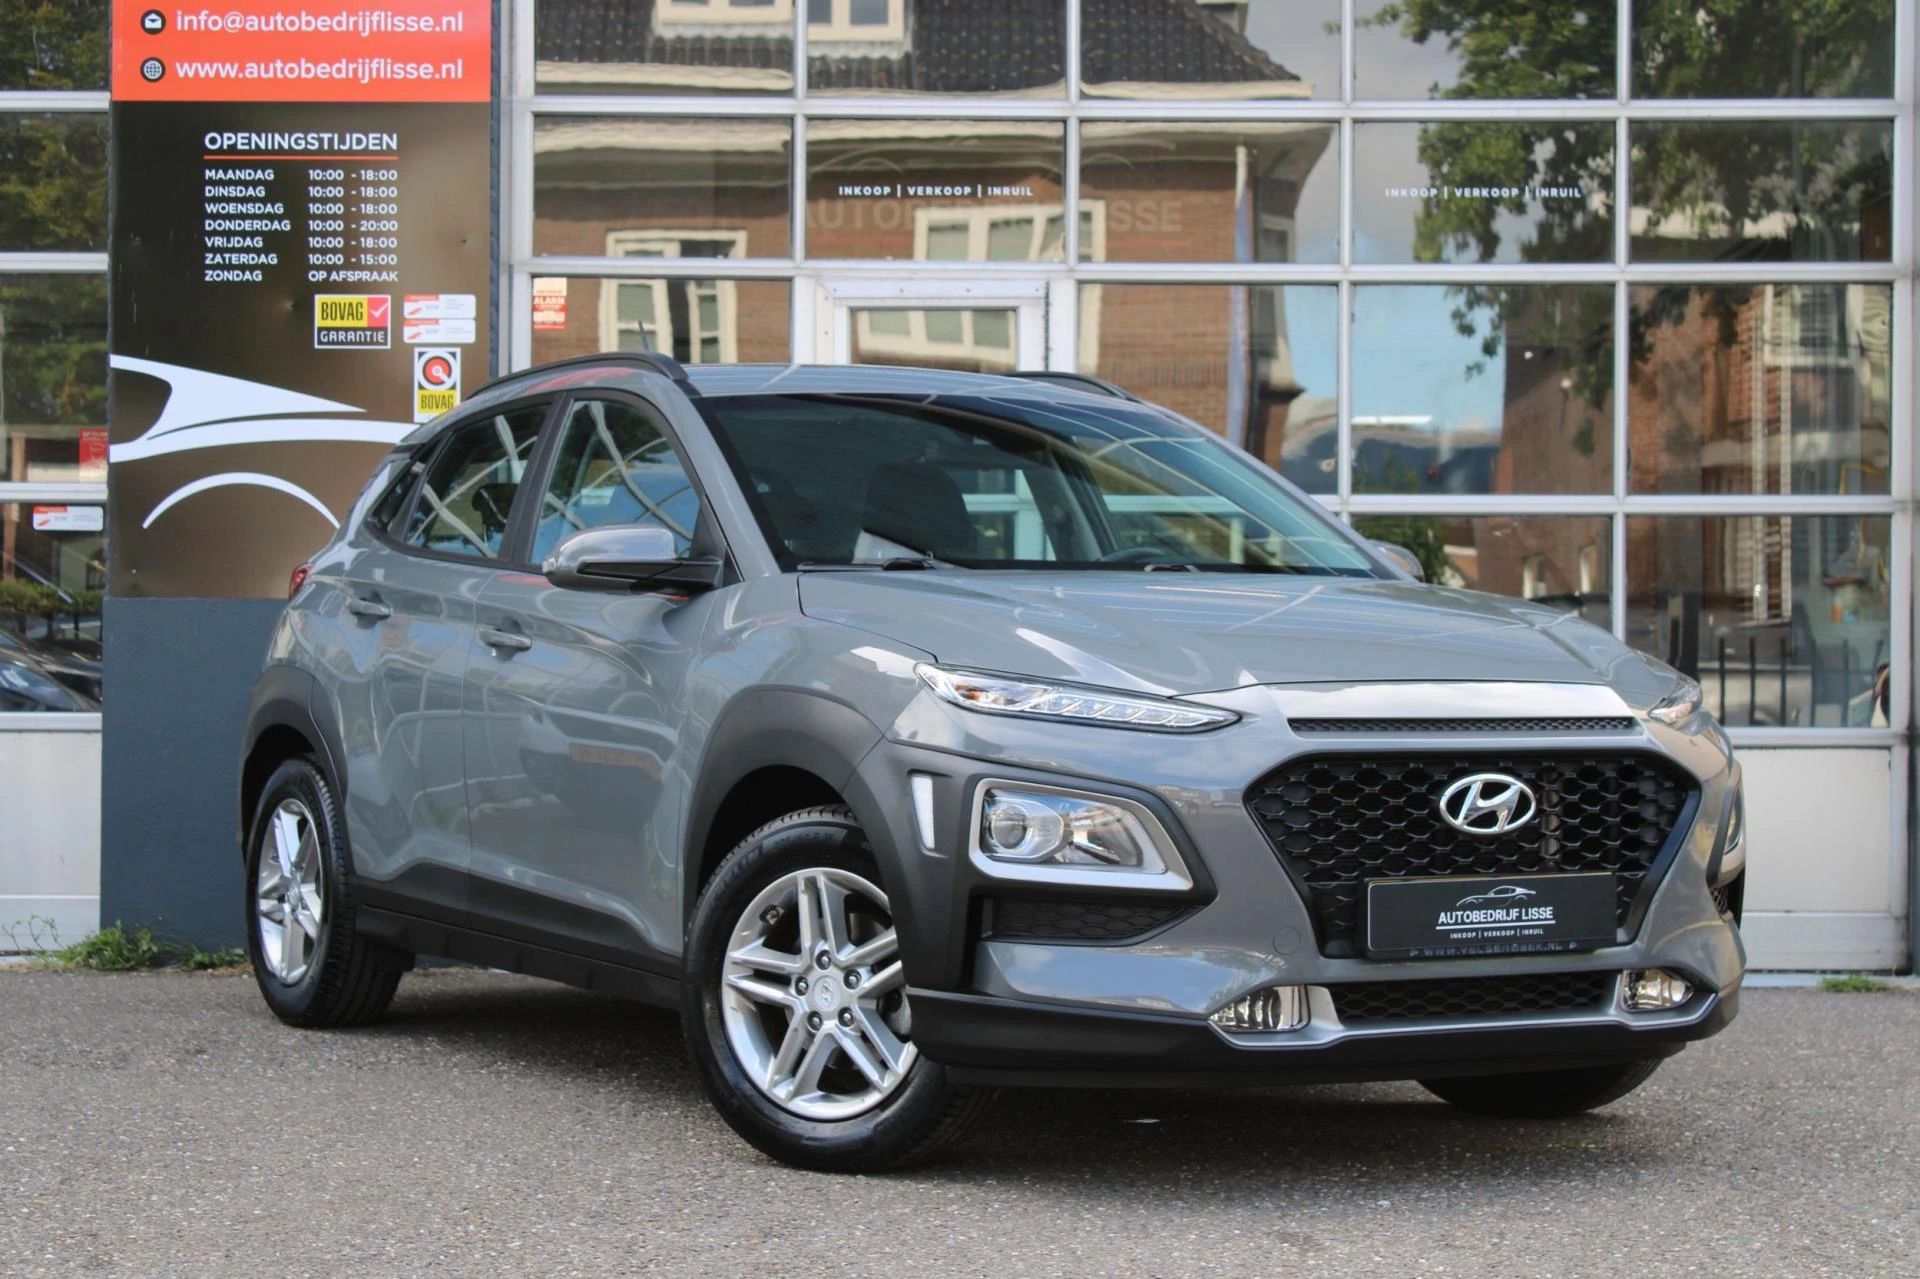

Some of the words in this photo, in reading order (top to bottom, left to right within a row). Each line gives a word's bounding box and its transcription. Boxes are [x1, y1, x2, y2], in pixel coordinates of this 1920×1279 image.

[176, 10, 464, 36] info@autobedrijflisse.nl
[175, 58, 463, 84] www.autobedrijflisse.nl
[204, 132, 398, 151] OPENINGSTIJDEN
[206, 169, 275, 181] MAANDAG
[308, 169, 344, 181] 10:00
[360, 169, 398, 181] 18:00
[205, 186, 266, 198] DINSDAG
[308, 186, 344, 198] 10:00
[360, 186, 398, 198] 18:00
[838, 185, 891, 196] INKOOP
[908, 185, 972, 196] VERKOOP
[987, 185, 1034, 196] INRUIL
[1385, 187, 1438, 197] INKOOP
[1454, 187, 1519, 197] VERKOOP
[1535, 187, 1581, 197] INRUIL
[205, 203, 284, 215] WOENSDAG
[308, 203, 344, 215] 10:00
[360, 203, 398, 215] 18:00
[205, 219, 291, 232] DONDERDAG
[308, 219, 344, 231] 10:00
[360, 219, 398, 231] 20:00
[205, 236, 263, 248] VRIJDAG
[308, 236, 344, 248] 10:00
[360, 236, 398, 248] 18:00
[205, 253, 277, 265] ZATERDAG
[308, 253, 344, 265] 10:00
[360, 253, 398, 265] 15:00
[205, 270, 263, 282] ZONDAG
[308, 270, 328, 282] OP
[329, 270, 398, 282] AFSPRAAK
[321, 301, 364, 321] BOVAG
[320, 330, 385, 343] GARANTIE
[420, 394, 454, 410] BOVAG
[1438, 908, 1520, 924] AUTOBEDRIJF
[1521, 907, 1554, 920] LISSE
